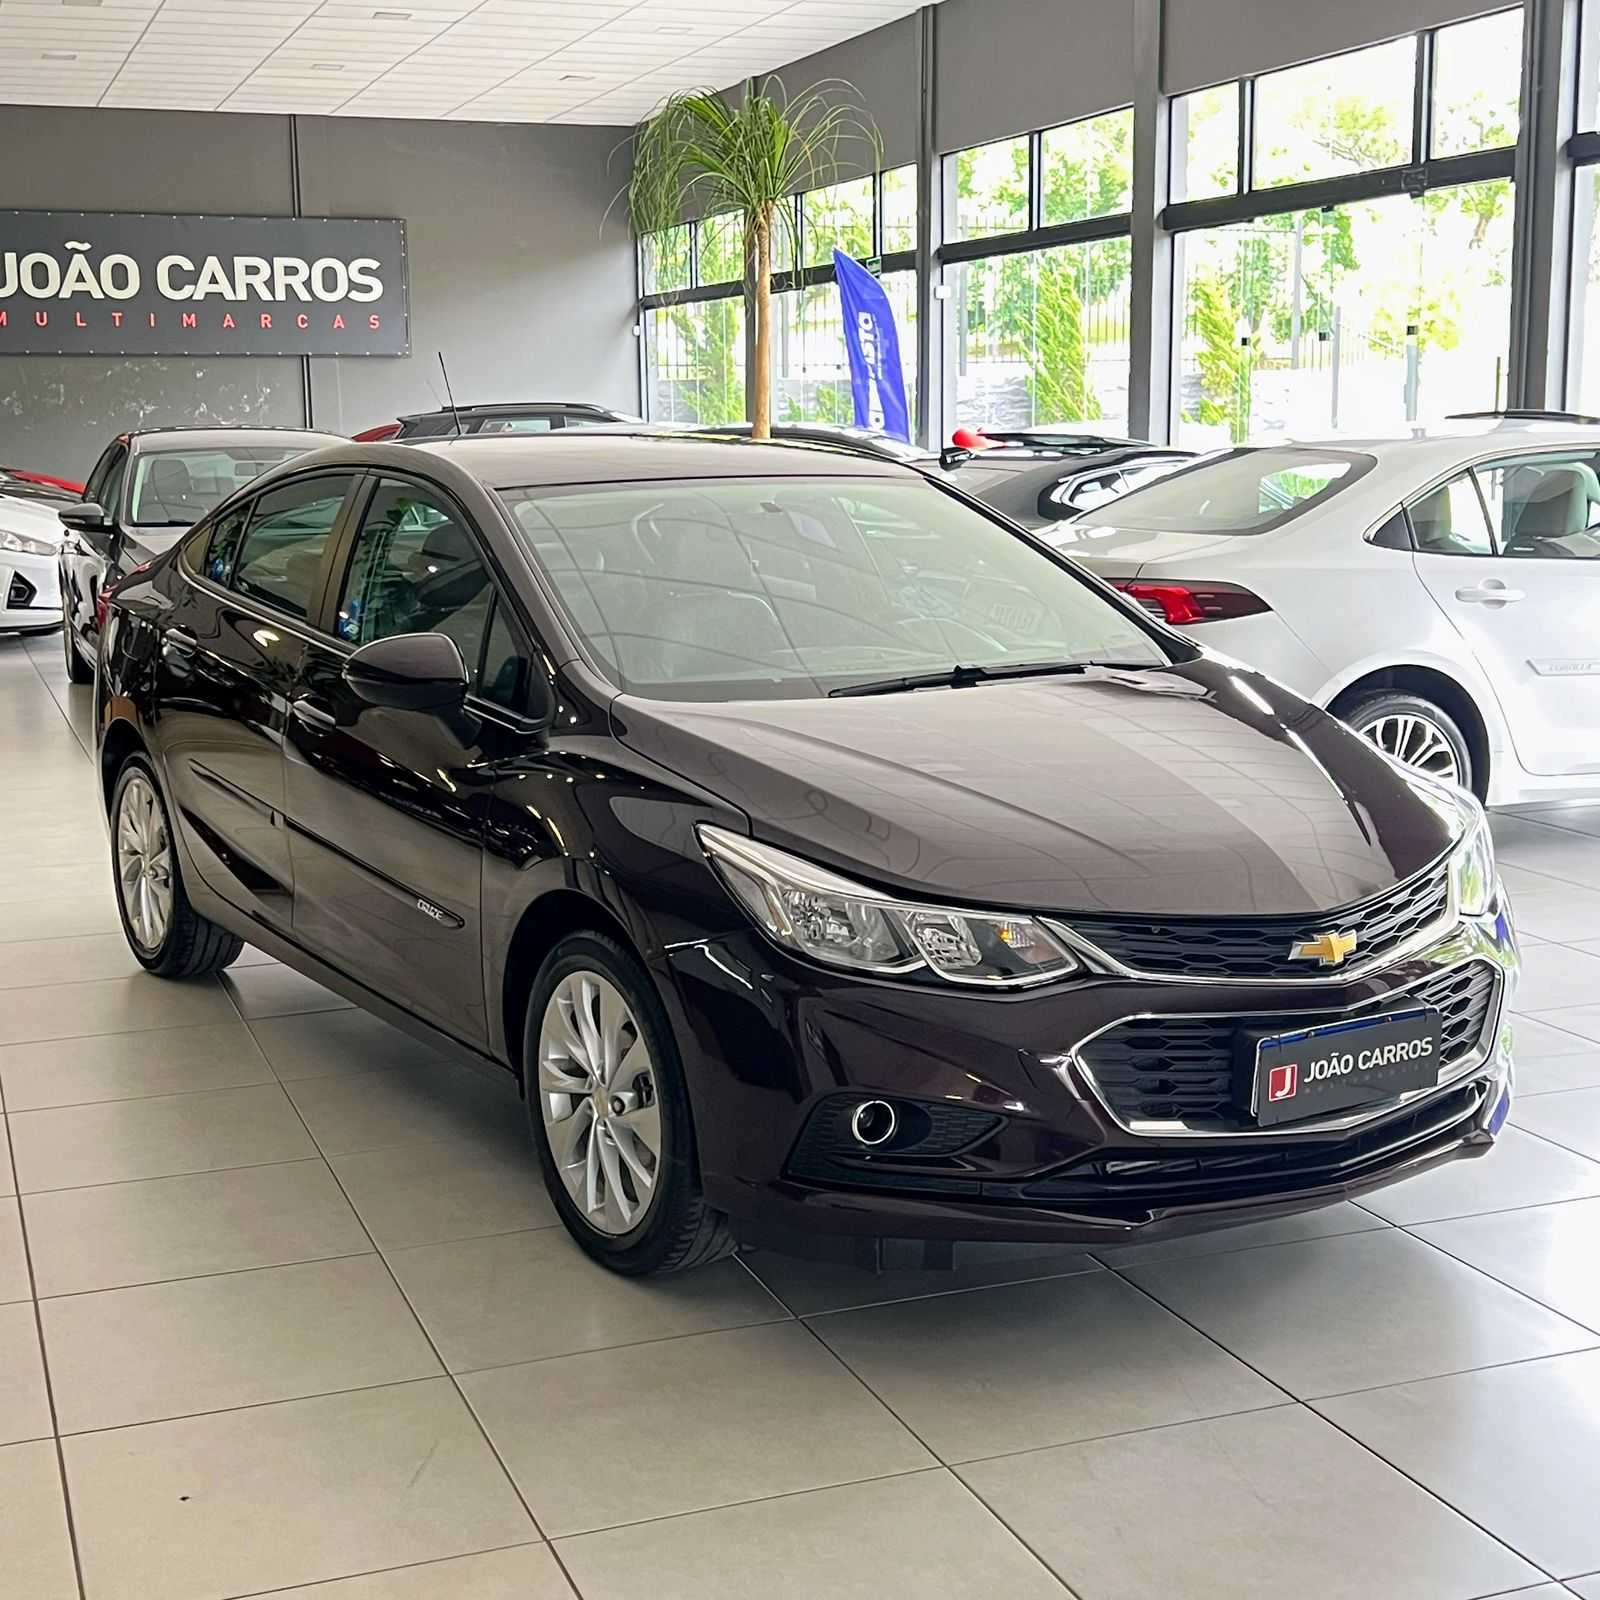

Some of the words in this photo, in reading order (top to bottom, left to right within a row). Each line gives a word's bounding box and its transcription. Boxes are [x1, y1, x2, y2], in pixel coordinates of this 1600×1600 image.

[0, 240, 140, 300] JOÃO
[156, 254, 384, 303] CARROS
[1303, 1052, 1354, 1083] JOÃO
[1358, 1037, 1433, 1071] CARROS
